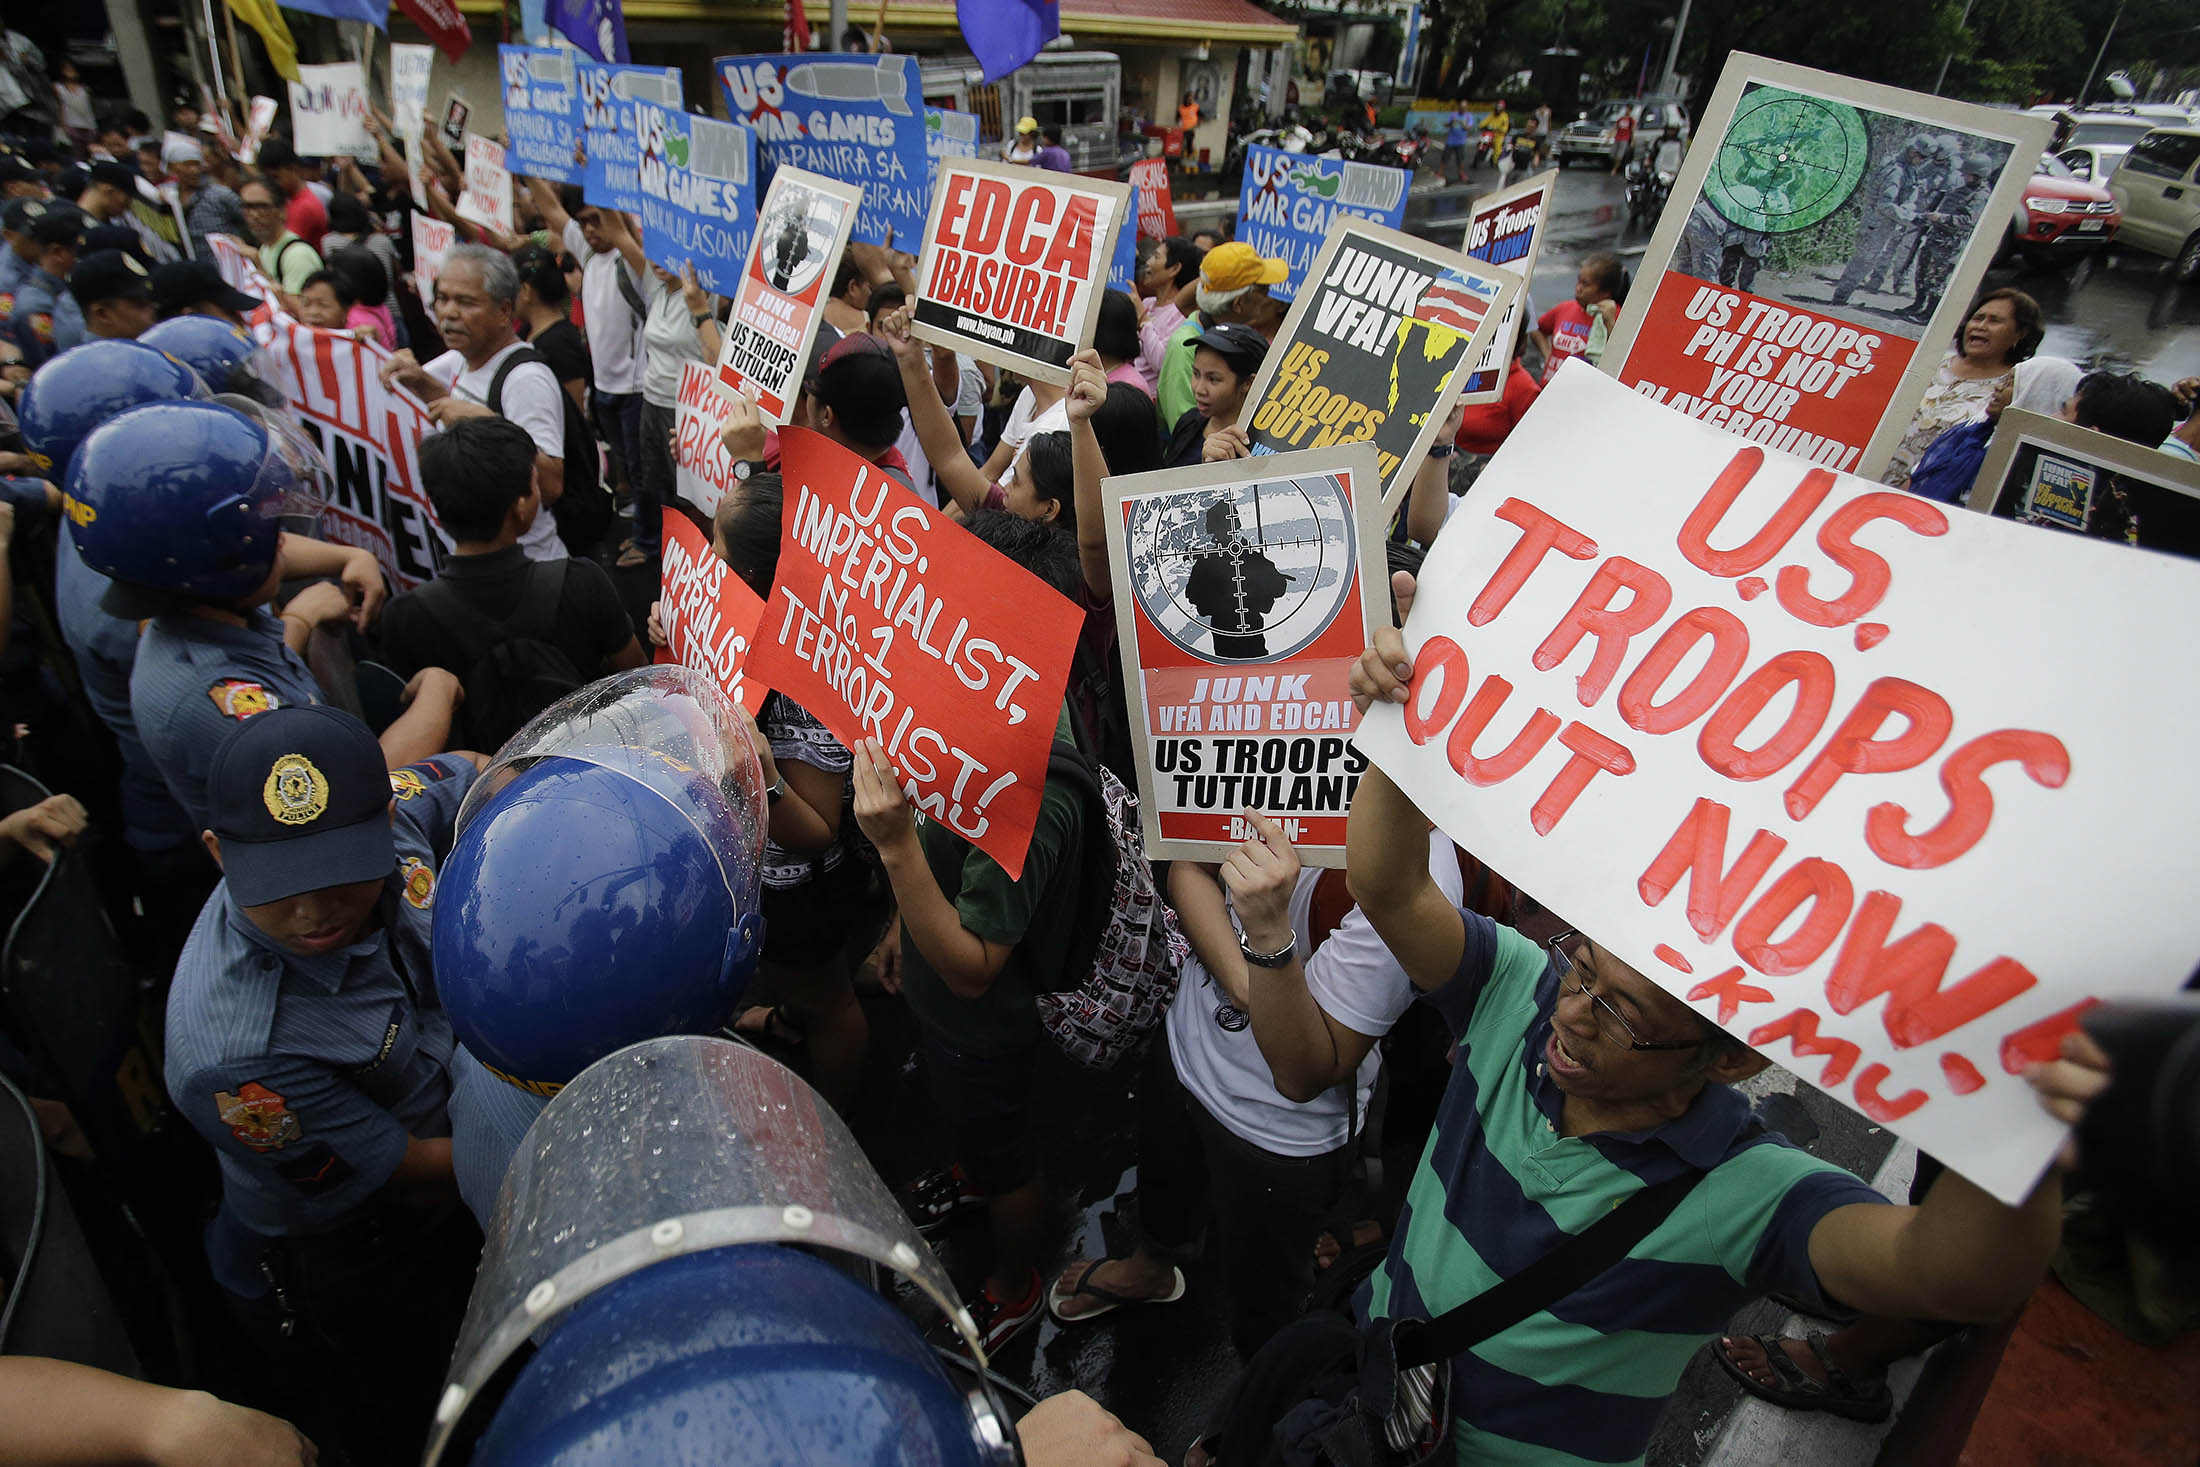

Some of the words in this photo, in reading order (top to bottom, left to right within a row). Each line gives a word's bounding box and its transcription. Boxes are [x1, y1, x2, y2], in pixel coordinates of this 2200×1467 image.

[579, 68, 611, 104] US
[724, 62, 784, 111] US
[634, 101, 665, 155] US
[736, 112, 804, 144] WAR
[808, 110, 896, 147] GAMES
[760, 145, 872, 176] MAPANIRA
[876, 151, 907, 181] SA
[1253, 151, 1291, 188] US
[668, 168, 739, 223] GAMES
[1247, 187, 1289, 228] WAR
[935, 174, 1099, 280] EDCA
[1470, 217, 1491, 250] US
[755, 290, 797, 322] JUNK
[927, 248, 1077, 337] IBASURA!
[1325, 247, 1433, 317] JUNK
[731, 322, 750, 349] US
[749, 331, 797, 375] TROOPS
[741, 302, 757, 325] VFA
[754, 308, 774, 334] AND
[774, 321, 801, 348] EDCA!
[956, 314, 1015, 346] www.bayan.ph
[1313, 290, 1402, 357] VFA!
[1684, 286, 1741, 327] US
[1737, 300, 1882, 375] TROOPS,
[730, 345, 787, 394] TUTULAN!
[1281, 341, 1331, 380] US
[1683, 324, 1744, 366] PH
[1733, 339, 1782, 377] IS
[1775, 352, 1860, 399] NOT
[1267, 371, 1387, 441] TROOPS
[1702, 366, 1800, 421] YOUR
[1252, 402, 1318, 446] OUT
[677, 413, 739, 494] IBAGSA
[849, 465, 931, 575] U.S.
[1676, 445, 1949, 651] U.S.
[662, 536, 750, 682] IMPERIALIS
[791, 485, 1041, 726] IMPERIALIST,
[863, 625, 896, 679] 1
[778, 585, 1018, 813] TERRORIST!
[1189, 674, 1312, 704] JUNK
[1467, 496, 2071, 870] TROOPS
[1158, 706, 1202, 732] VFA
[1209, 704, 1262, 731] AND
[1270, 700, 1353, 730] EDCA!
[1155, 739, 1203, 774] US
[1212, 737, 1370, 774] TROOPS
[1173, 775, 1360, 812] TUTULAN!
[1403, 635, 1636, 837] OUT
[1637, 797, 2102, 1096] NOW!
